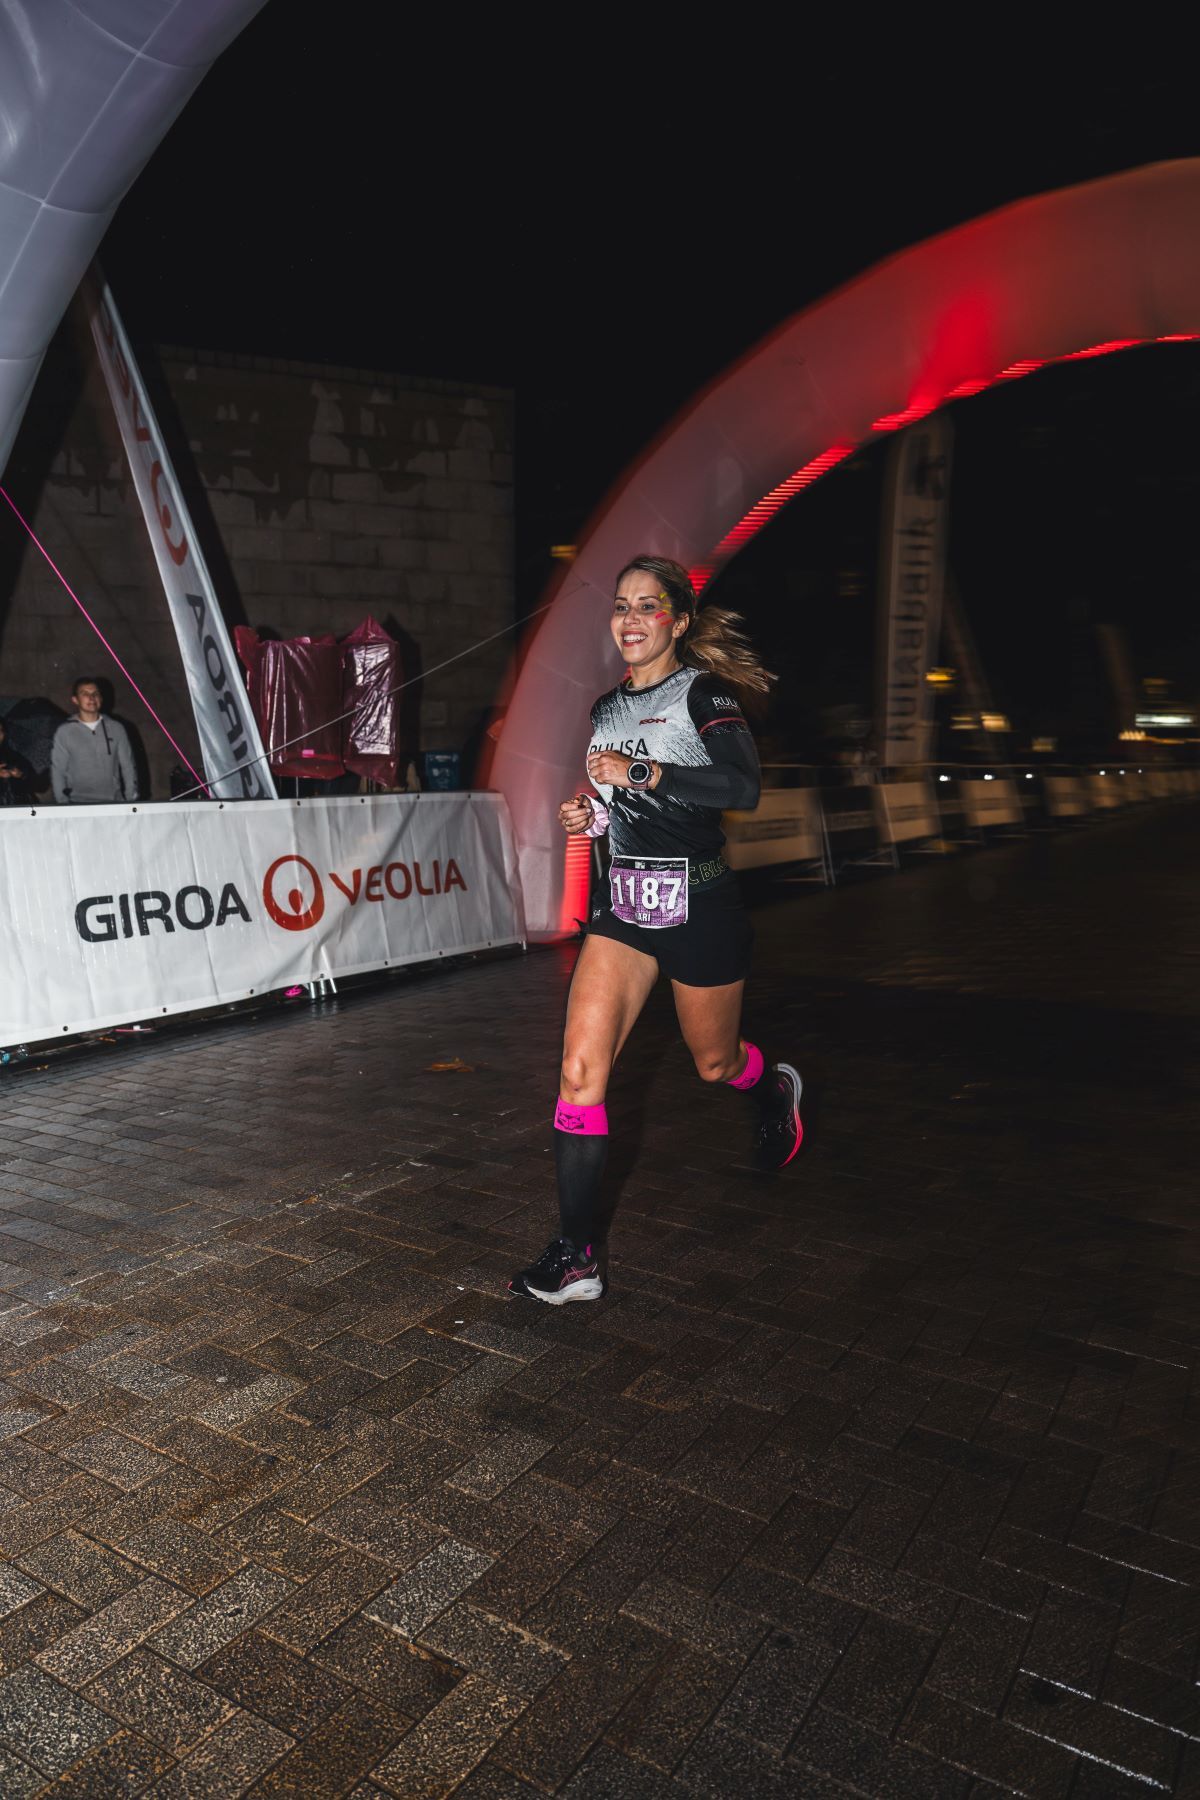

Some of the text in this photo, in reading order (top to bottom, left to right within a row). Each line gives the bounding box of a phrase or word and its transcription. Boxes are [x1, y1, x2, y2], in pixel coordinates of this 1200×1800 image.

[75, 858, 468, 942] GIROA VEOLIA
[613, 874, 682, 910] 1187
